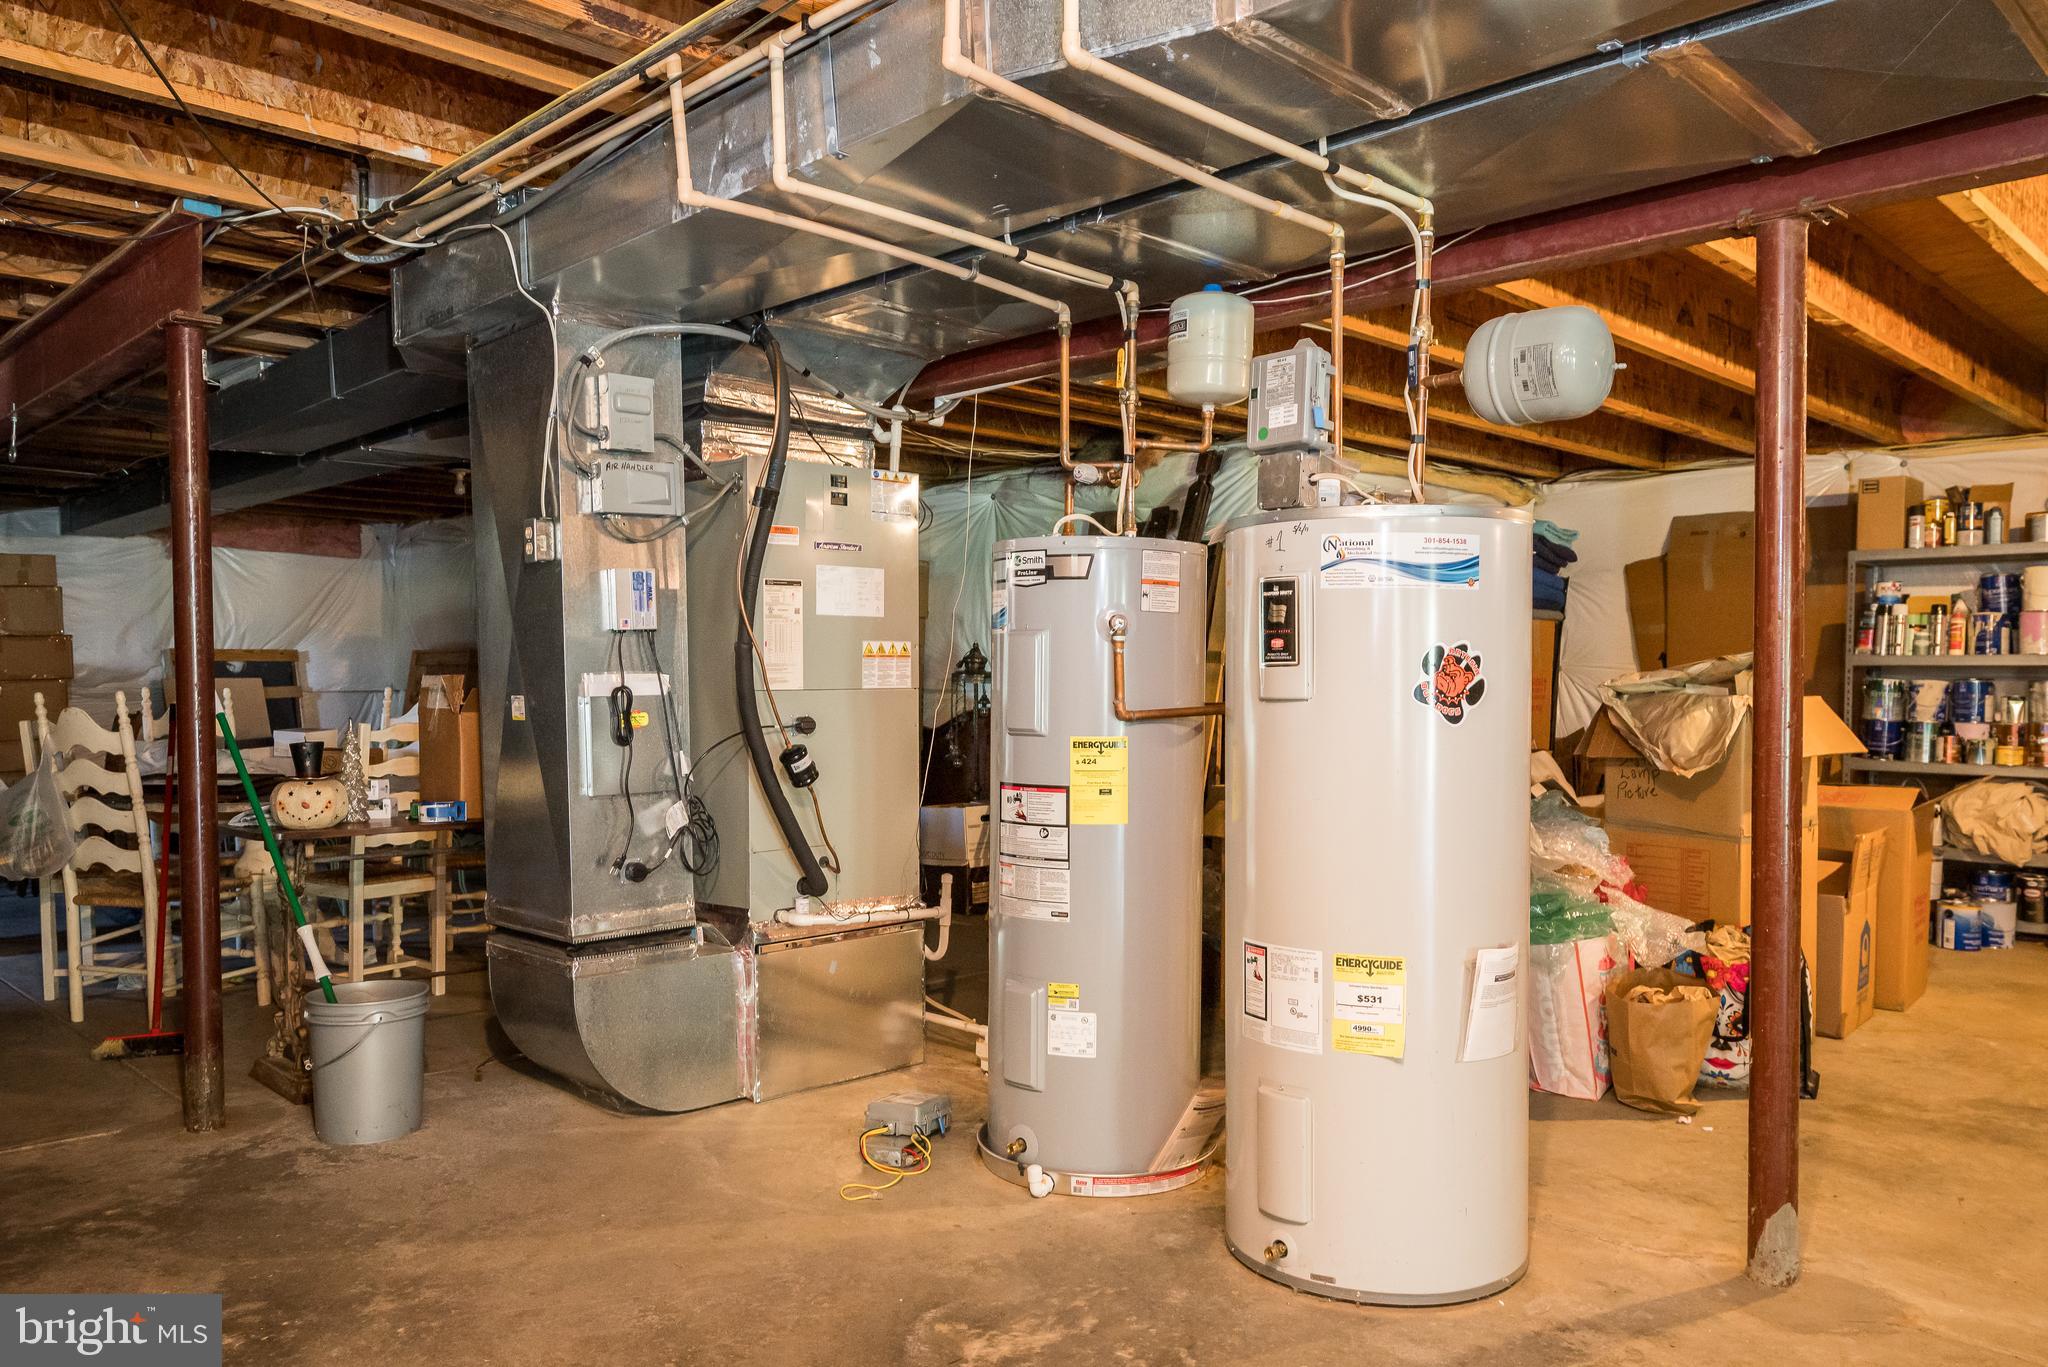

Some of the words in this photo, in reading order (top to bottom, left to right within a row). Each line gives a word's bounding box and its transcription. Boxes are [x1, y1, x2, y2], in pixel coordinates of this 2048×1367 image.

[605, 461, 618, 471] AIR
[621, 461, 655, 471] HANDLER
[1424, 537, 1467, 545] 301-854-1538
[1021, 556, 1044, 565] Smith
[1072, 740, 1128, 753] ENERGYGUIE
[1620, 768, 1660, 787] Lamp
[1616, 780, 1659, 799] Picture
[1335, 957, 1403, 973] ENERGYGUIDE
[1357, 994, 1383, 1004] $531
[1352, 1024, 1372, 1032] 4990
